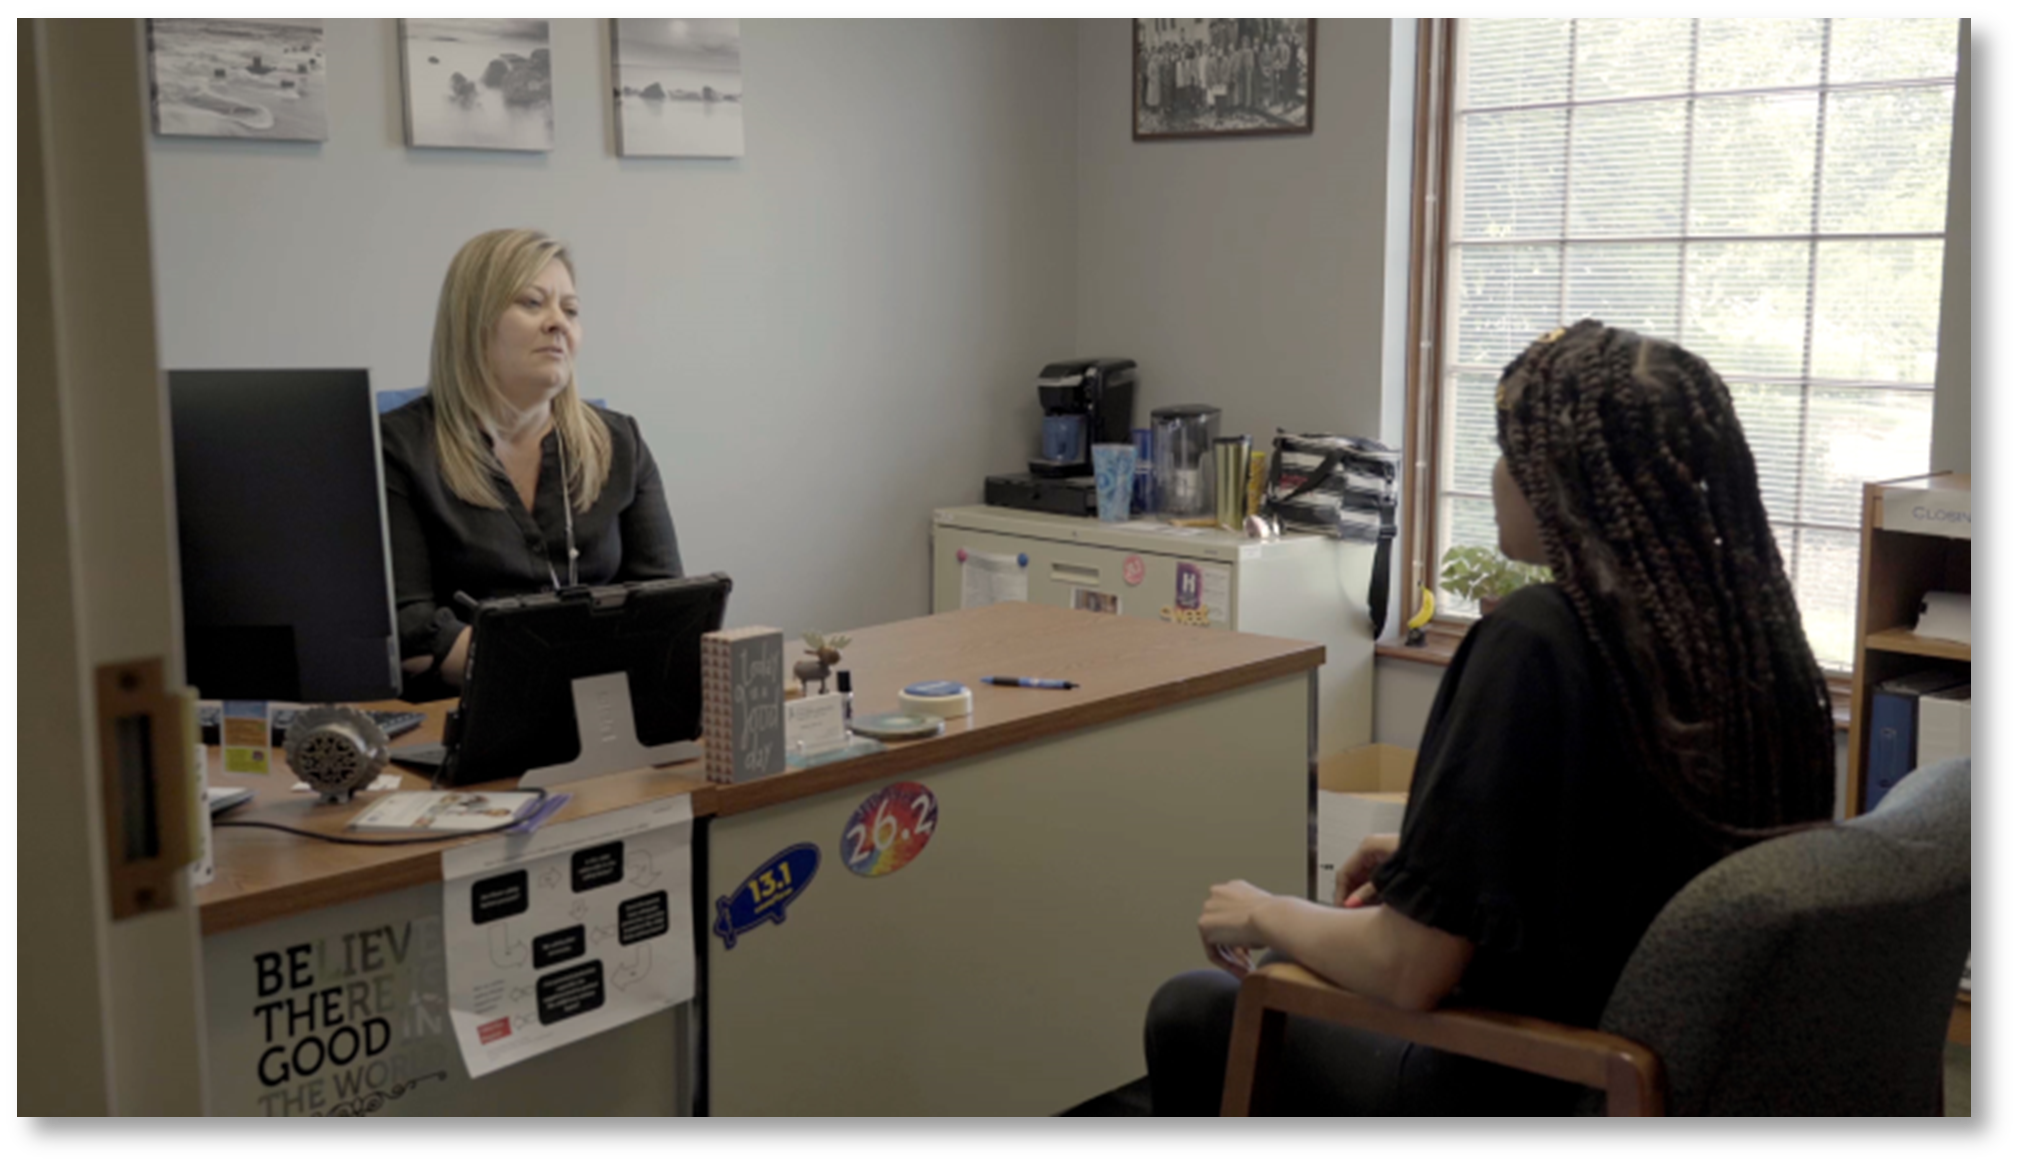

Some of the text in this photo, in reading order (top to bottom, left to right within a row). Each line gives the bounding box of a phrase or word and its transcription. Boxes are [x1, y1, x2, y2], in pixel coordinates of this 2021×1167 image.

[846, 793, 933, 865] 26.2
[748, 861, 793, 904] 13.1
[254, 975, 395, 1042] THERE
[258, 1017, 391, 1086] GOOD
[258, 1077, 327, 1116] THE
